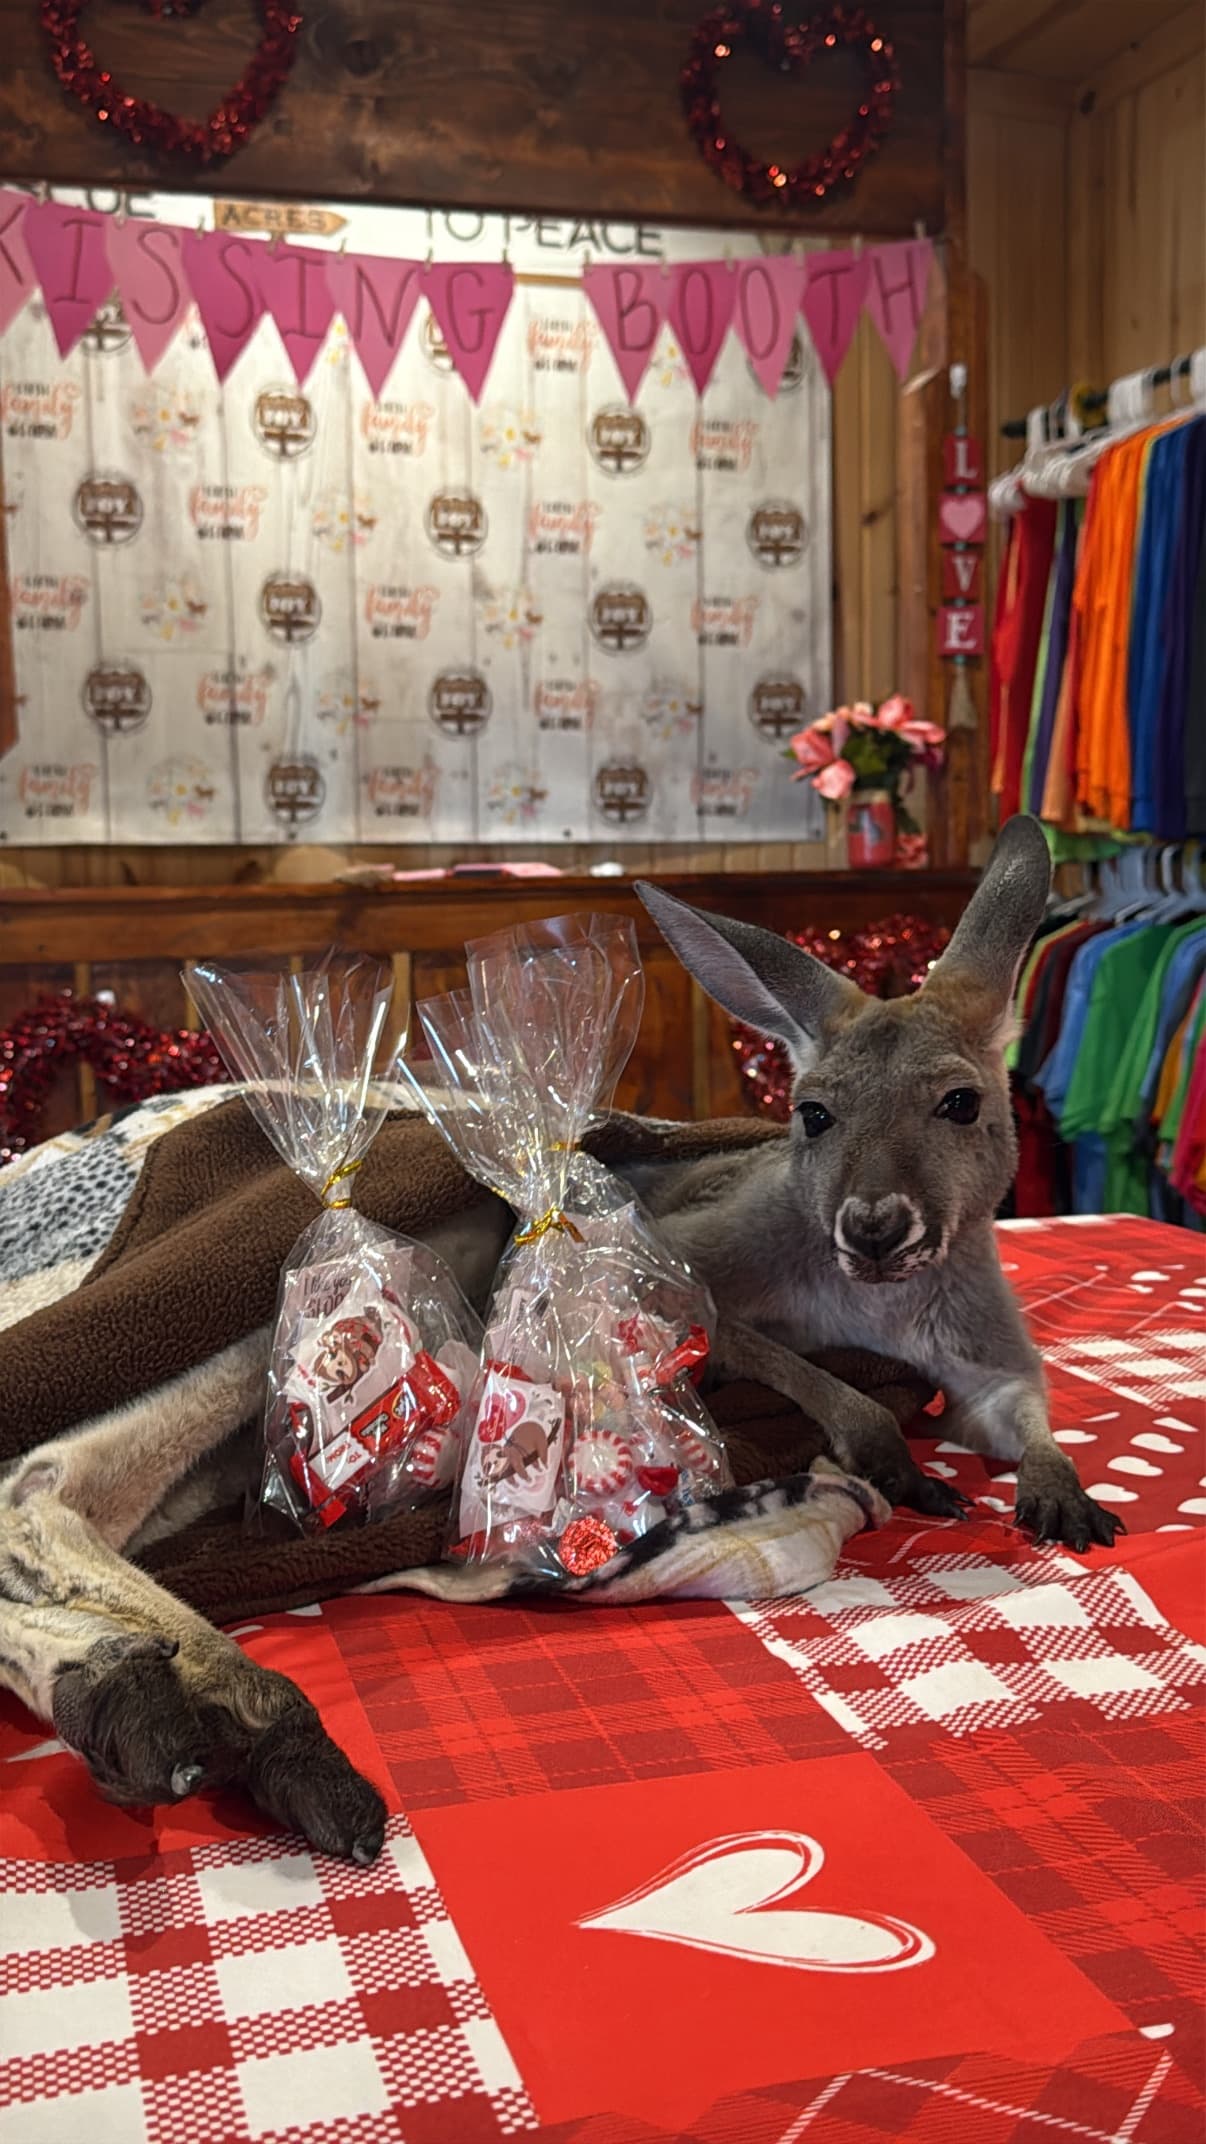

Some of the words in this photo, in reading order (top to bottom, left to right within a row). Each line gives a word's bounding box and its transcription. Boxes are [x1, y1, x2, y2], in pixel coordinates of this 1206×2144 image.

[222, 204, 327, 230] ACRES
[503, 214, 664, 257] PEACE
[612, 243, 922, 360] BOOTH
